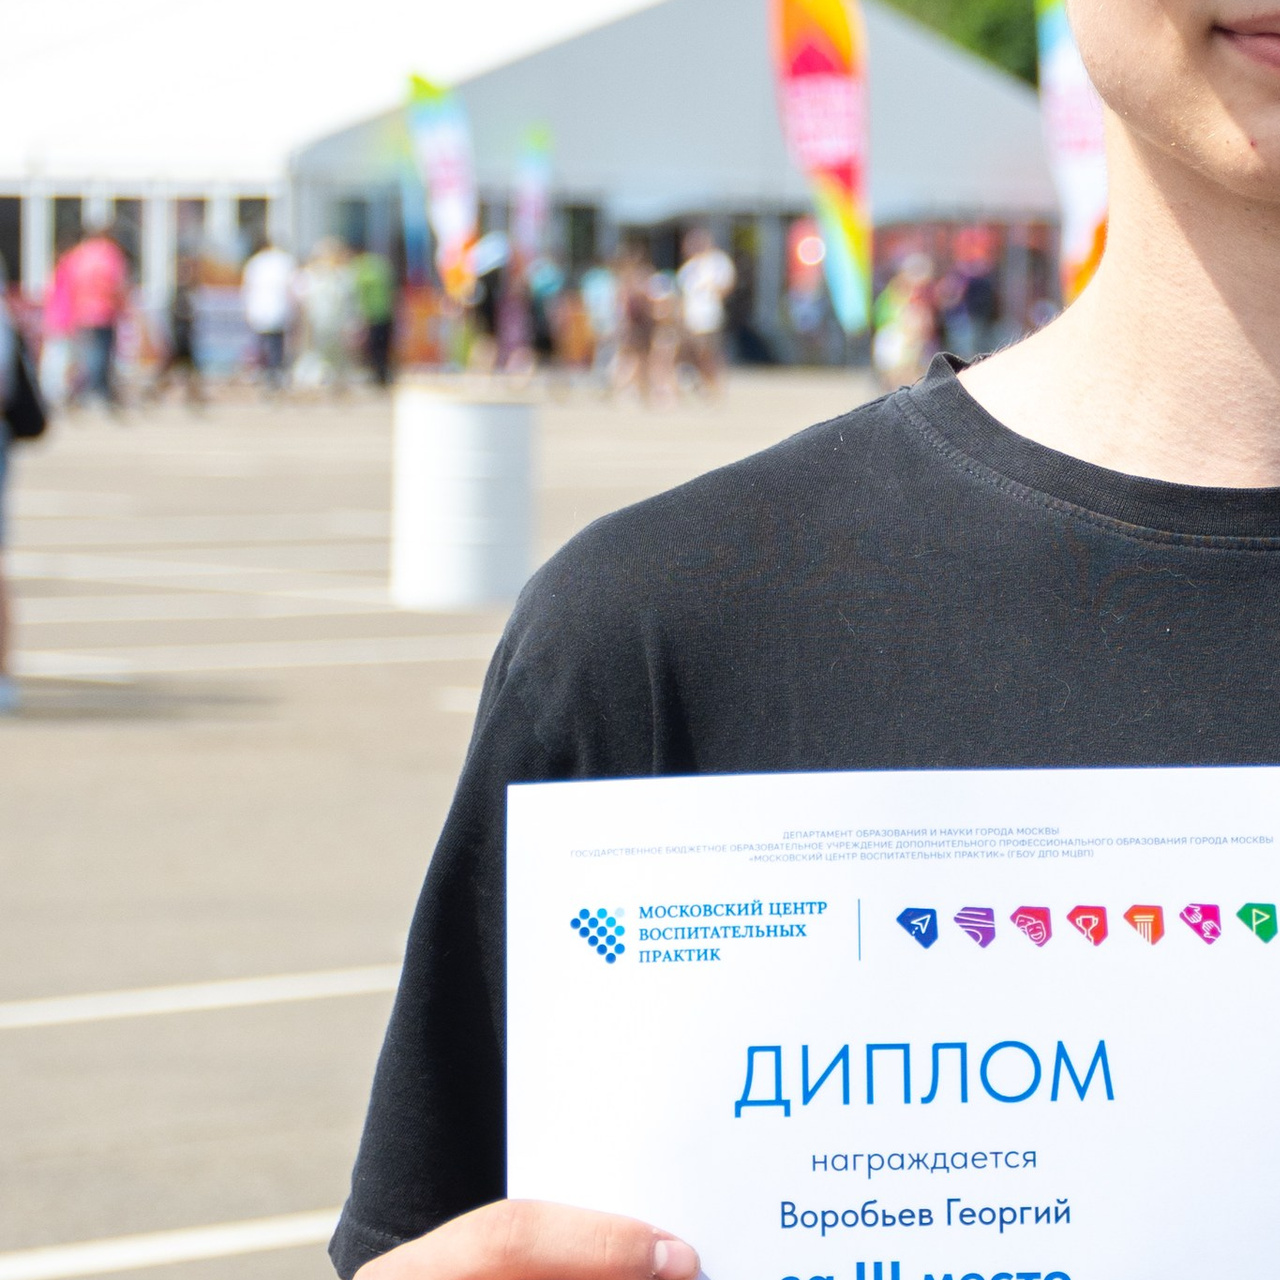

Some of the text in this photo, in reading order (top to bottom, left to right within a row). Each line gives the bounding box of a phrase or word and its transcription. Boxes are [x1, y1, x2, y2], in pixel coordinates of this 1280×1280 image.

[783, 827, 1059, 839] ДЕПАРТАМЕНТ ОБРАЗОВАНИЯ И НАУКИ ГОРОДА МОСКВЫ
[730, 842, 823, 852] ОБРАЗОВАТЕЛЬНОЕ
[826, 841, 892, 850] УЧРЕЖДЕНИЕ
[895, 839, 996, 849] ДОПОЛНИТЕЛЬНОГО
[999, 837, 1113, 847] ПРОФЕССИОНАЛЬНОГО
[1116, 837, 1187, 846] ОБРАЗОВАНИЯ
[1190, 836, 1228, 845] ГОРОДА
[1231, 836, 1273, 844] МОСКВЫ
[825, 852, 857, 862] ЦЕНТР
[860, 851, 951, 860] ВОСПИТАТЕЛЬНЫХ
[1038, 849, 1059, 859] ДПО
[640, 900, 827, 918] МОСКОВСКИЙ ЦЕНТР
[639, 924, 807, 941] ВОСПИТАТЕЛЬНЫХ
[640, 948, 720, 963] ПРАКТИК
[735, 1040, 1114, 1118] ДИПЛОМ
[812, 1151, 1036, 1179] награждается
[781, 1198, 1070, 1237] Воробьев Георгий
